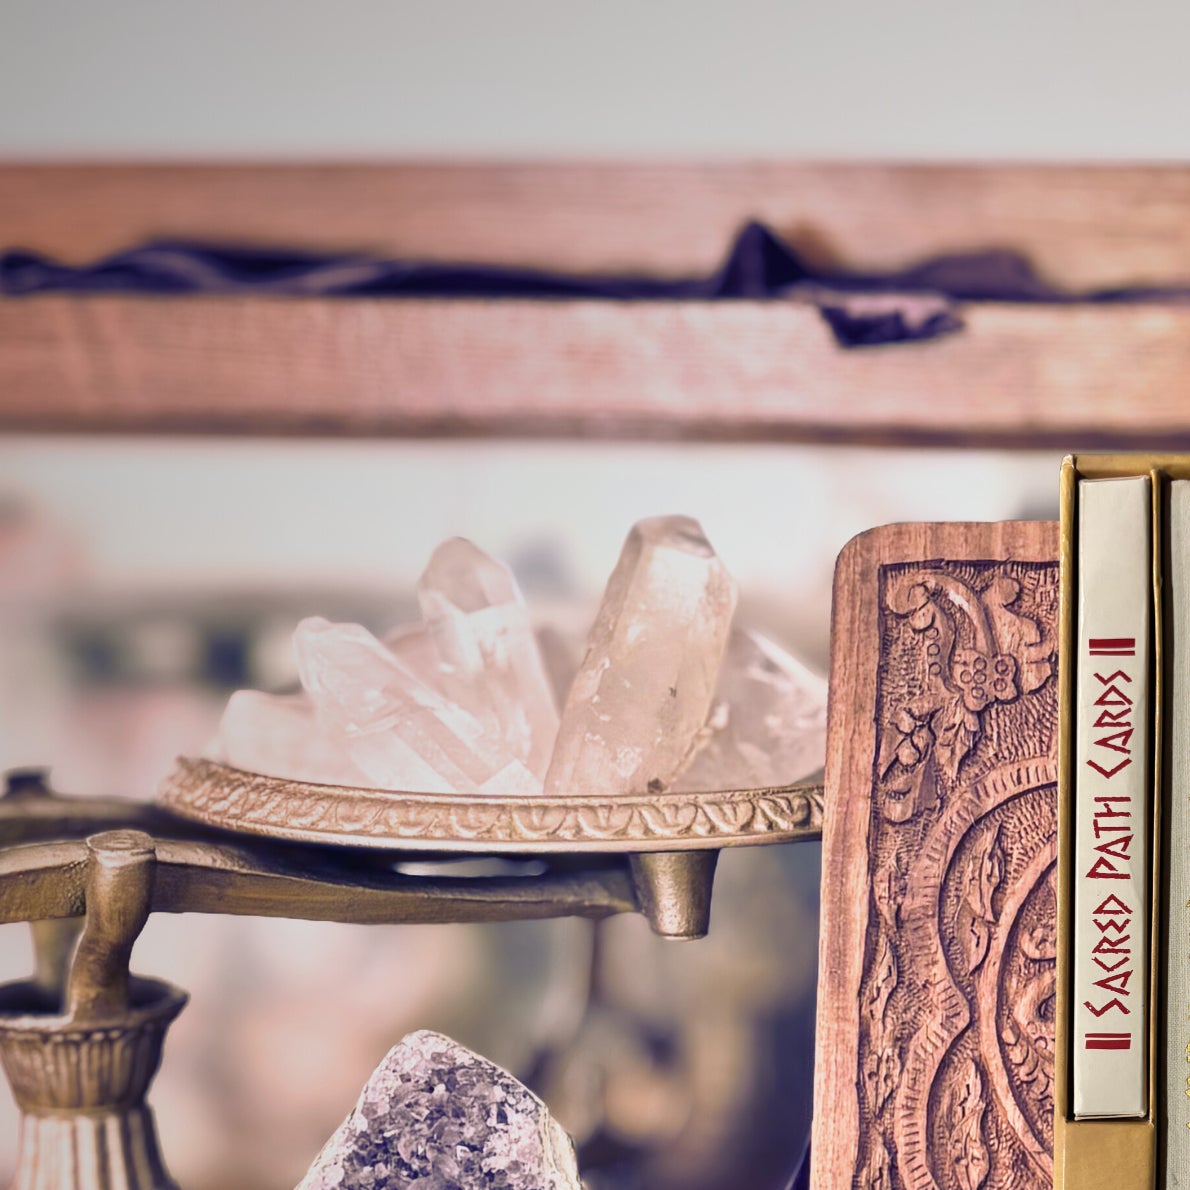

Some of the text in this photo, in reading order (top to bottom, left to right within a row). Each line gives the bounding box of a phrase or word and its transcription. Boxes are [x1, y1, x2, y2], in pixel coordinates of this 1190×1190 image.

[1083, 669, 1135, 1018] SACRED PATH CARDS
